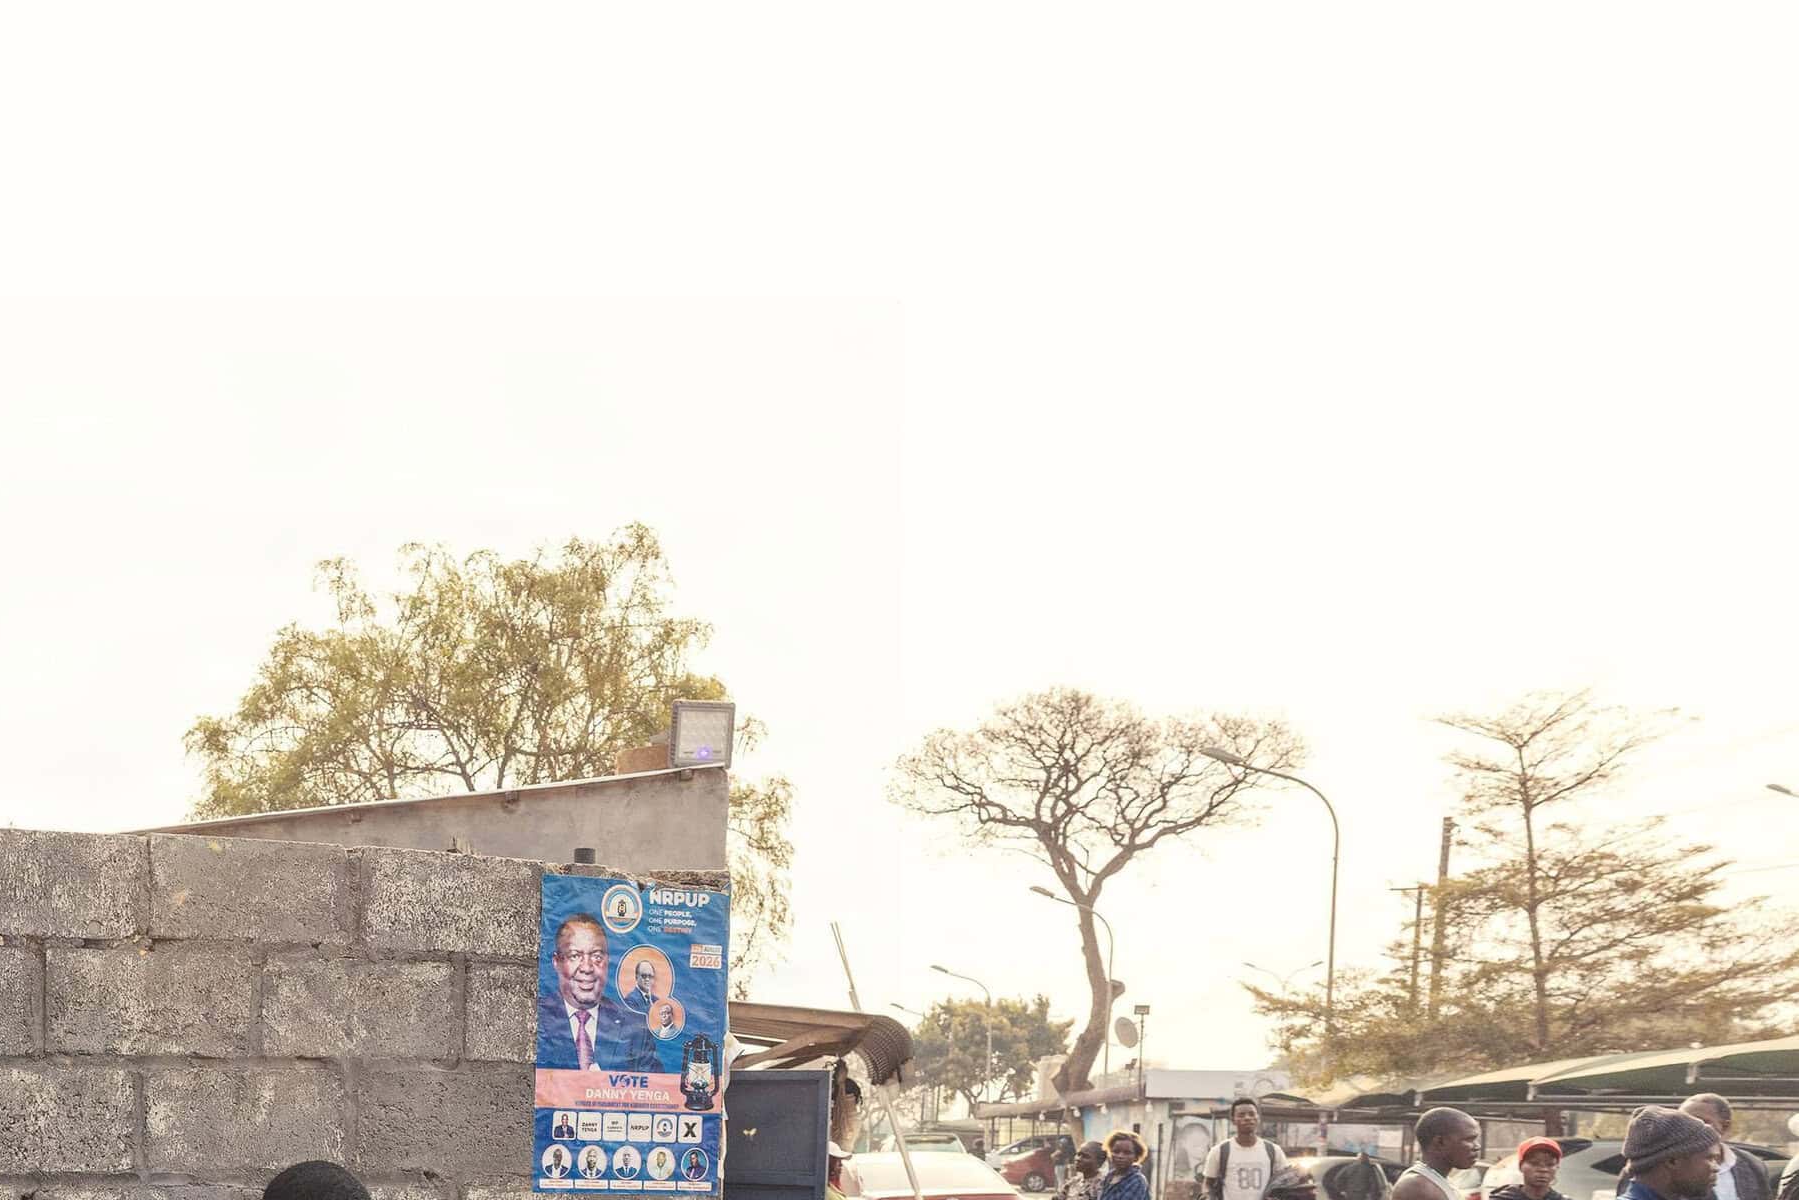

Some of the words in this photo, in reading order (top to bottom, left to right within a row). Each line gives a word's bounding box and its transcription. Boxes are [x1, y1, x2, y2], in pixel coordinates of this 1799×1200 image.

[649, 889, 710, 907] NRPUP
[692, 955, 721, 967] 2026
[609, 1074, 648, 1088] VOTE
[586, 1088, 627, 1099] DANNY
[630, 1090, 669, 1101] YENGA
[1237, 1168, 1262, 1190] 80
